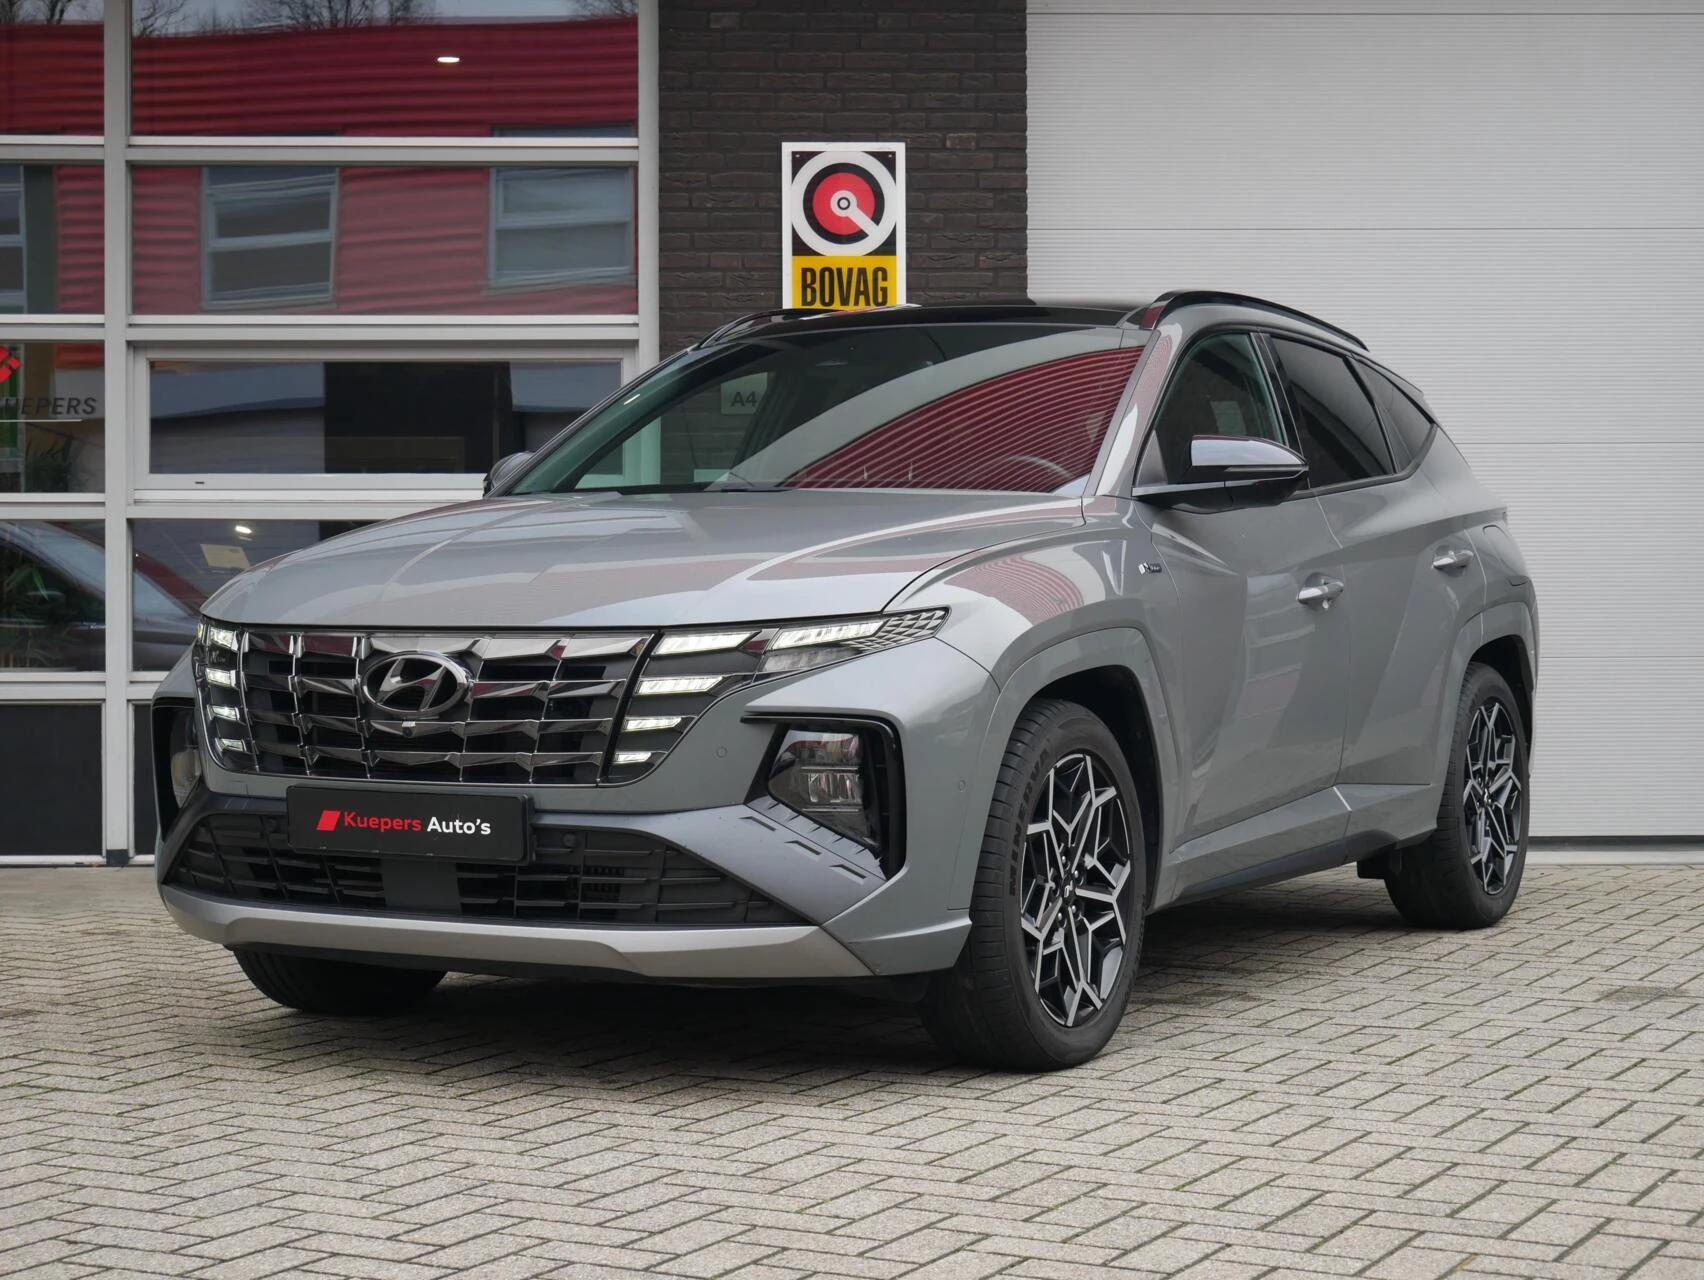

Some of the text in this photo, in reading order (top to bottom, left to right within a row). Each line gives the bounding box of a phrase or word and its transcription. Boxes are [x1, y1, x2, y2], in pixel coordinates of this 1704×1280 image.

[801, 267, 888, 307] BOVAG
[0, 397, 97, 415] UEPERS
[731, 391, 757, 407] A4
[343, 811, 491, 835] Kuepers Auto's
